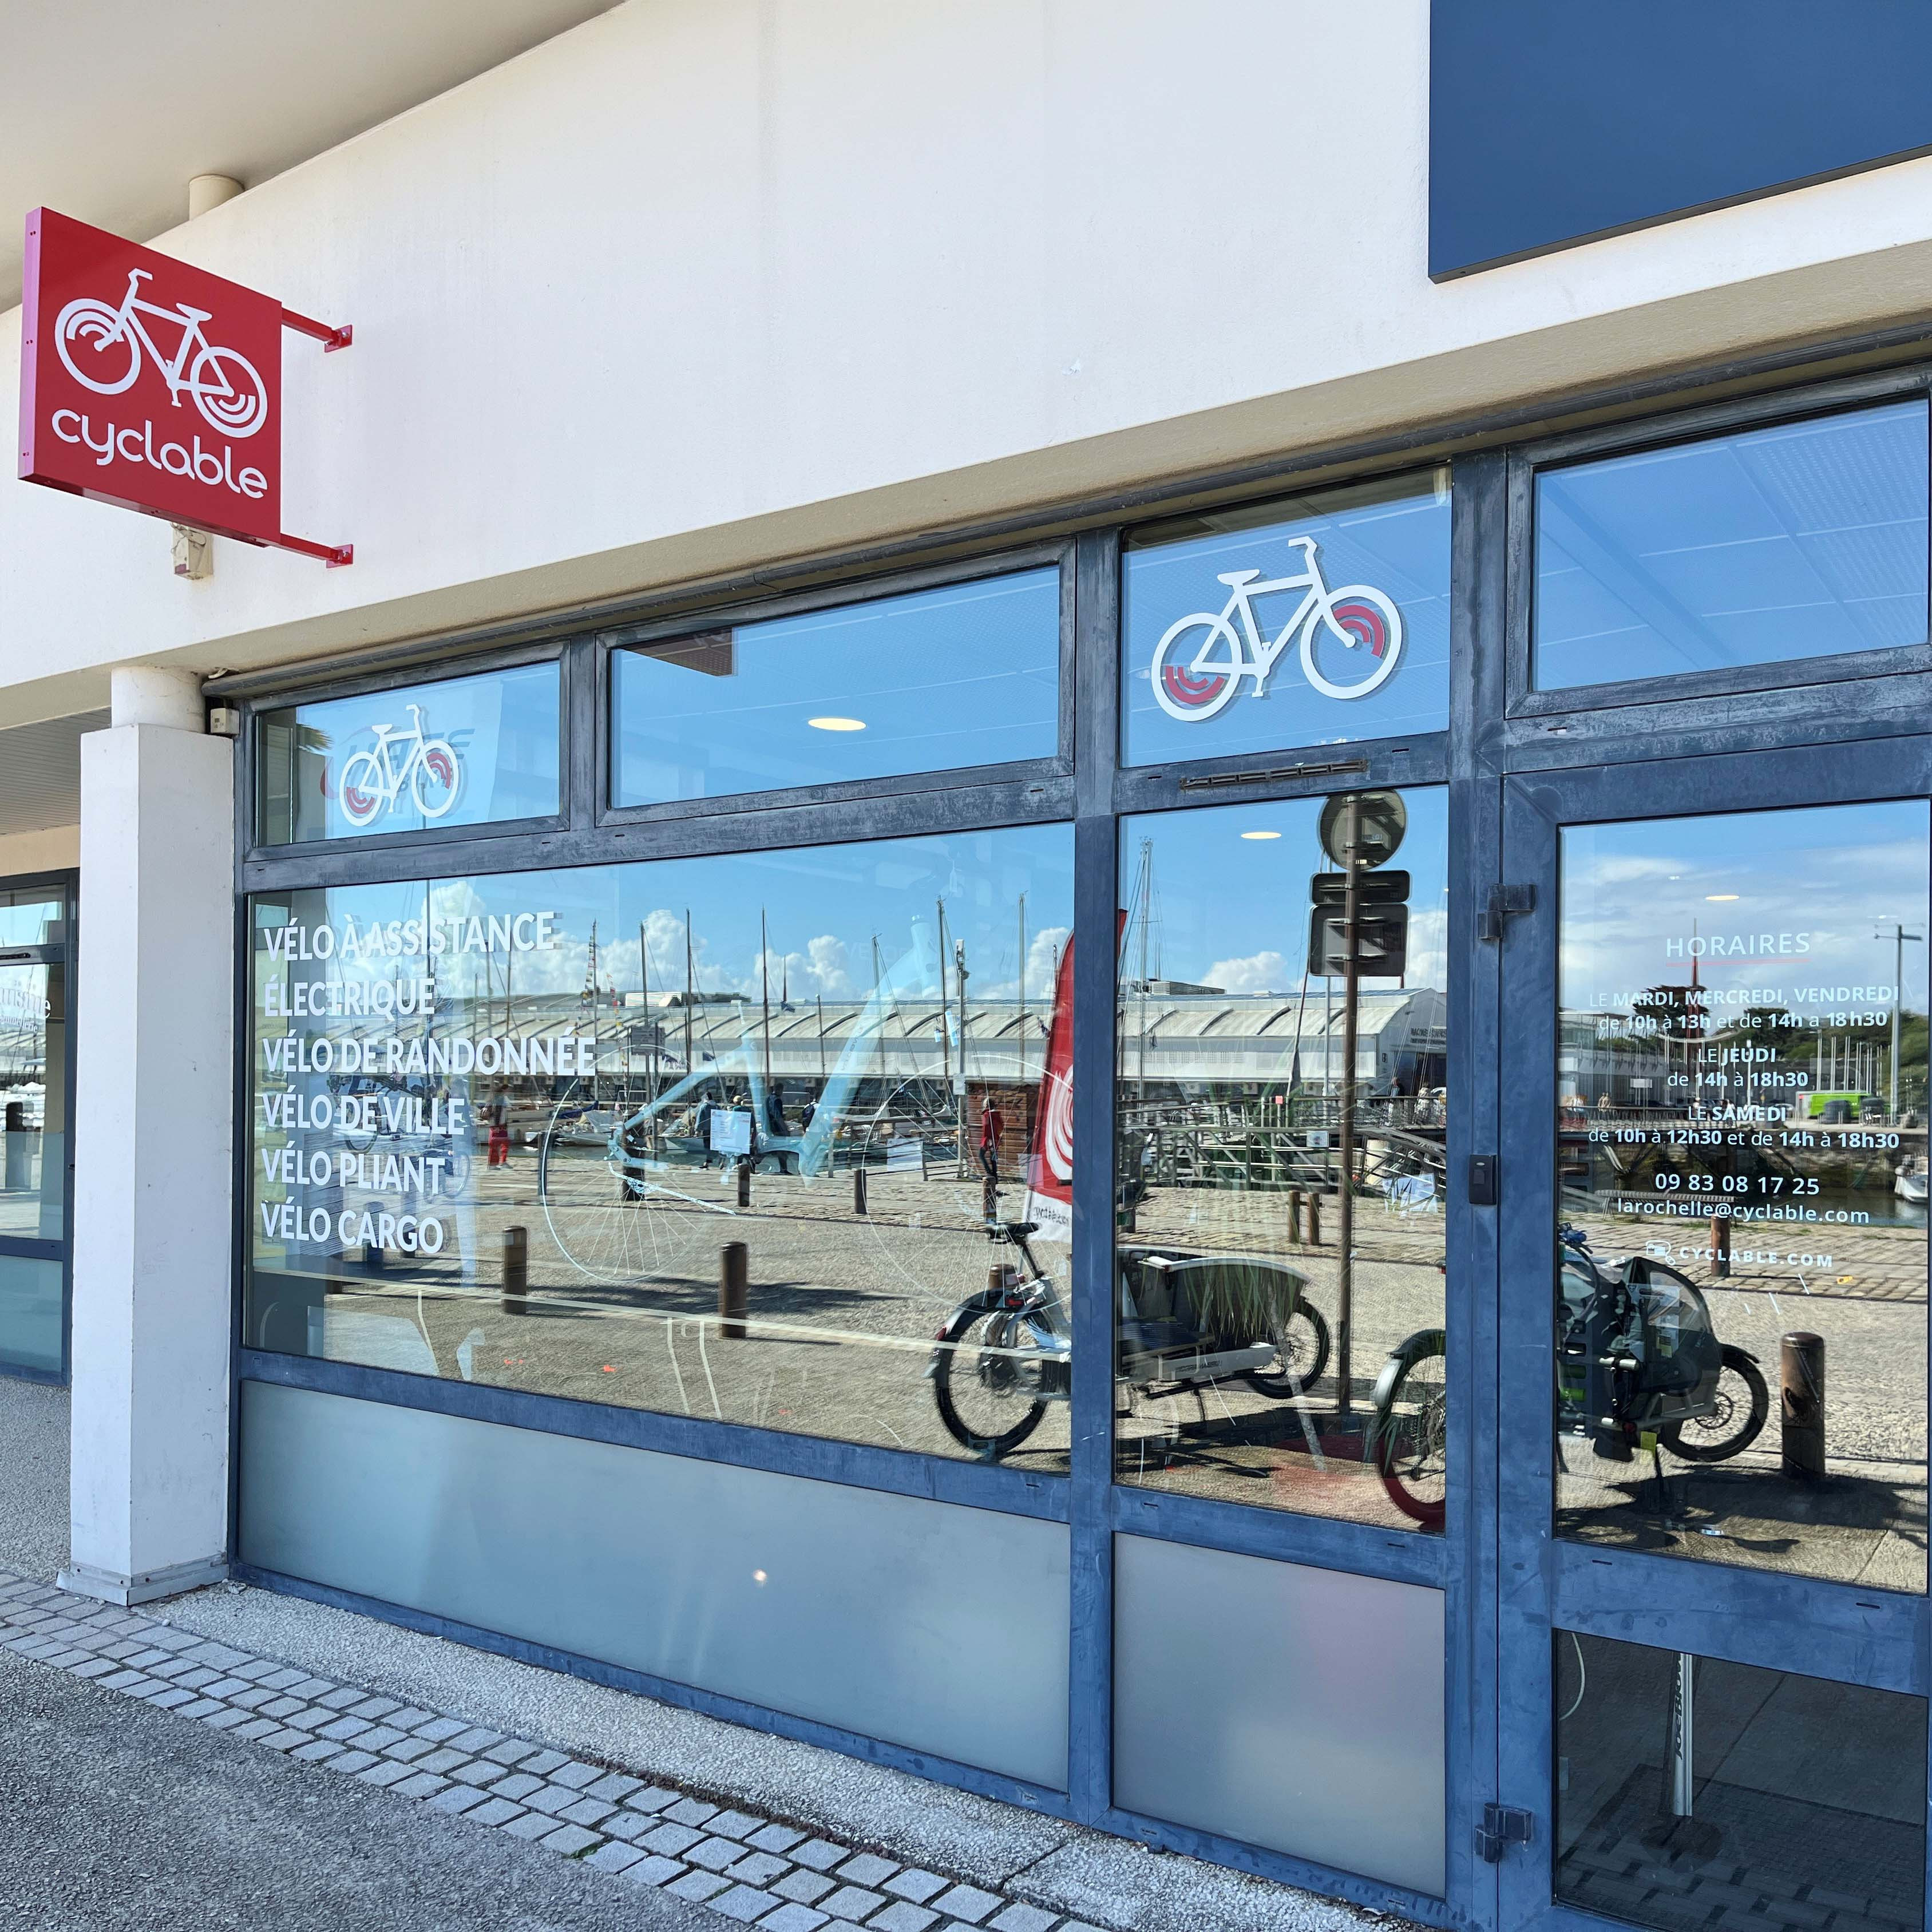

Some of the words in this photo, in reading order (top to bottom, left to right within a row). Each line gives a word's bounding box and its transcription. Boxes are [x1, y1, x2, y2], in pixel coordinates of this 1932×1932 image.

[52, 409, 267, 498] cyclable
[264, 918, 334, 962] VÉLO
[341, 914, 359, 957] À
[363, 911, 555, 957] ASSISTANCE
[1666, 933, 1810, 957] HORAIRES
[265, 975, 435, 1020] ÉLECTRIQUE
[1590, 993, 1608, 1007] LE
[1613, 991, 1679, 1008] MARDI,
[1685, 989, 1788, 1006] MERCREDI,
[1794, 987, 1898, 1003] VENDREDI
[1600, 1016, 1619, 1030] de
[1625, 1015, 1657, 1030] 10h
[1662, 1014, 1672, 1028] à
[1680, 1014, 1710, 1028] 13h
[1717, 1015, 1734, 1028] et
[1740, 1013, 1761, 1028] de
[1769, 1012, 1802, 1027] 14h
[1827, 1011, 1887, 1027] 18h30
[263, 1030, 332, 1073] VÉLO
[341, 1038, 378, 1073] DE
[387, 1027, 596, 1076] RANDONNÉE
[1699, 1049, 1717, 1063] LE
[1721, 1048, 1775, 1065] JEUDI
[1668, 1072, 1688, 1087] de
[1695, 1072, 1727, 1087] 14h
[1734, 1071, 1742, 1086] à
[1751, 1071, 1807, 1087] 18h30
[263, 1086, 332, 1130] VÉLO
[341, 1096, 377, 1131] DE
[383, 1096, 464, 1135] VILLE
[1689, 1107, 1706, 1121] LE
[1712, 1107, 1786, 1121] SAMEDI
[1589, 1129, 1609, 1142] de
[1614, 1128, 1645, 1143] 10h
[1652, 1129, 1661, 1143] à
[1667, 1129, 1721, 1144] 12h30
[1728, 1133, 1745, 1145] et
[1751, 1130, 1772, 1146] de
[1779, 1131, 1813, 1146] 14h
[1821, 1132, 1830, 1147] à
[1838, 1132, 1899, 1149] 18h30
[262, 1141, 331, 1186] VÉLO
[341, 1153, 445, 1194] PLIANT
[1656, 1174, 1680, 1190] 09
[1689, 1175, 1713, 1190] 83
[1723, 1175, 1748, 1192] 08
[1758, 1177, 1783, 1193] 17
[1793, 1178, 1819, 1194] 25
[1618, 1198, 1870, 1223] larochelle@cyclable.com
[261, 1197, 331, 1242] VÉLO
[339, 1210, 443, 1253] CARGO
[1679, 1247, 1832, 1267] CYCLABLE.COM
